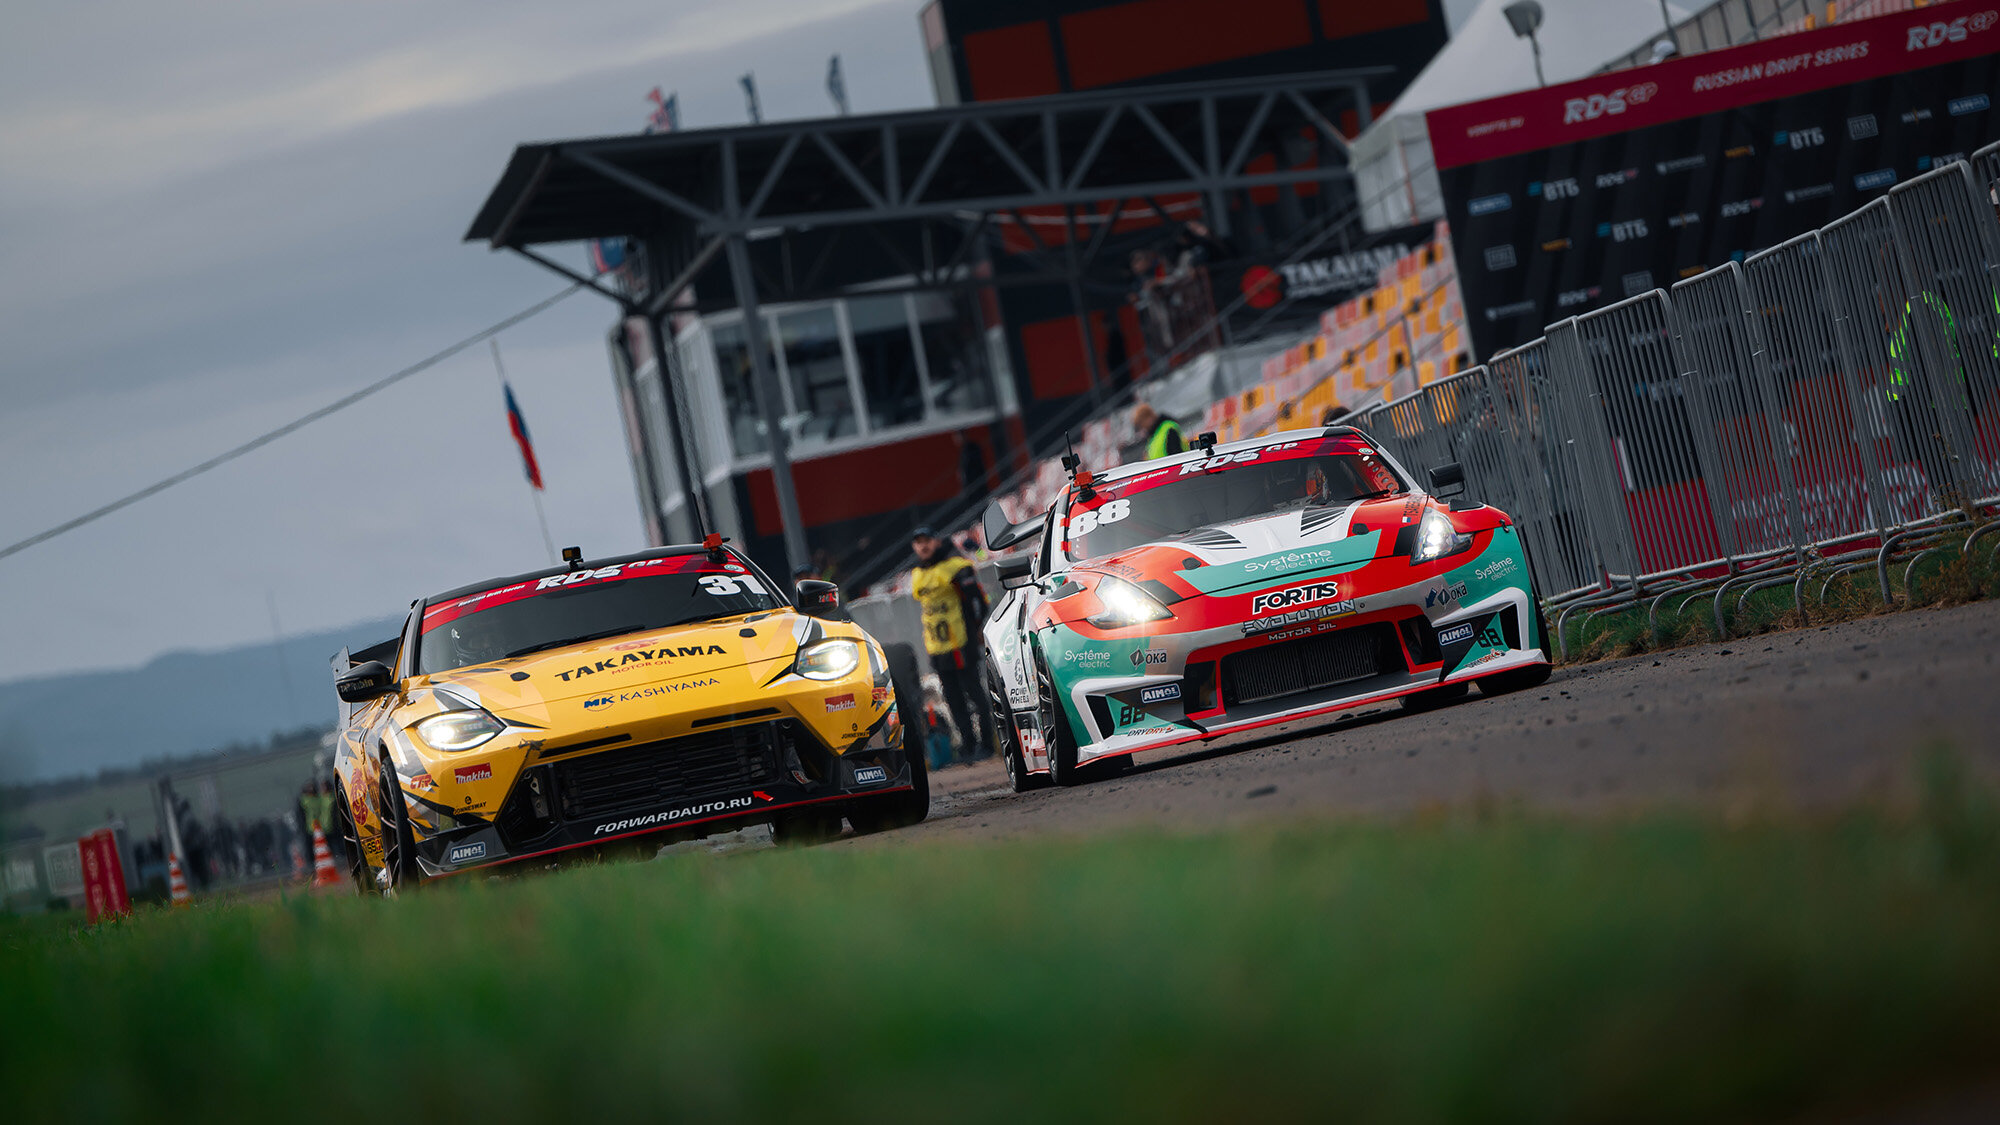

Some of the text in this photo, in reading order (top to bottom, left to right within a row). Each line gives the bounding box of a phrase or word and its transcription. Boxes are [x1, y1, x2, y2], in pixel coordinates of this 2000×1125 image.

[1905, 16, 1968, 51] RDS
[1693, 40, 1870, 92] RUSSIAN DRIFT SERIES
[1563, 89, 1626, 124] RDS
[1178, 441, 1300, 476] RDS GP
[1067, 499, 1131, 539] 88
[1244, 548, 1332, 573] Système
[1275, 555, 1335, 571] electric
[1475, 556, 1513, 580] Système
[1490, 563, 1519, 582] electric
[535, 559, 664, 591] RDS GP
[698, 574, 769, 596] 31
[1253, 582, 1338, 613] FORTIS
[1242, 600, 1356, 632] EVOLUTION
[1268, 622, 1337, 641] MOTOR OIL
[554, 644, 727, 682] TAKAYAMA
[1064, 648, 1111, 662] Système
[1078, 659, 1111, 668] electric
[611, 661, 652, 675] MOTOR
[583, 693, 616, 709] MK
[620, 677, 721, 702] KASHIYAMA
[1143, 685, 1179, 702] AIMOL
[593, 796, 752, 835] FORWARDAUTO.RU
[451, 844, 485, 862] AIMOL
